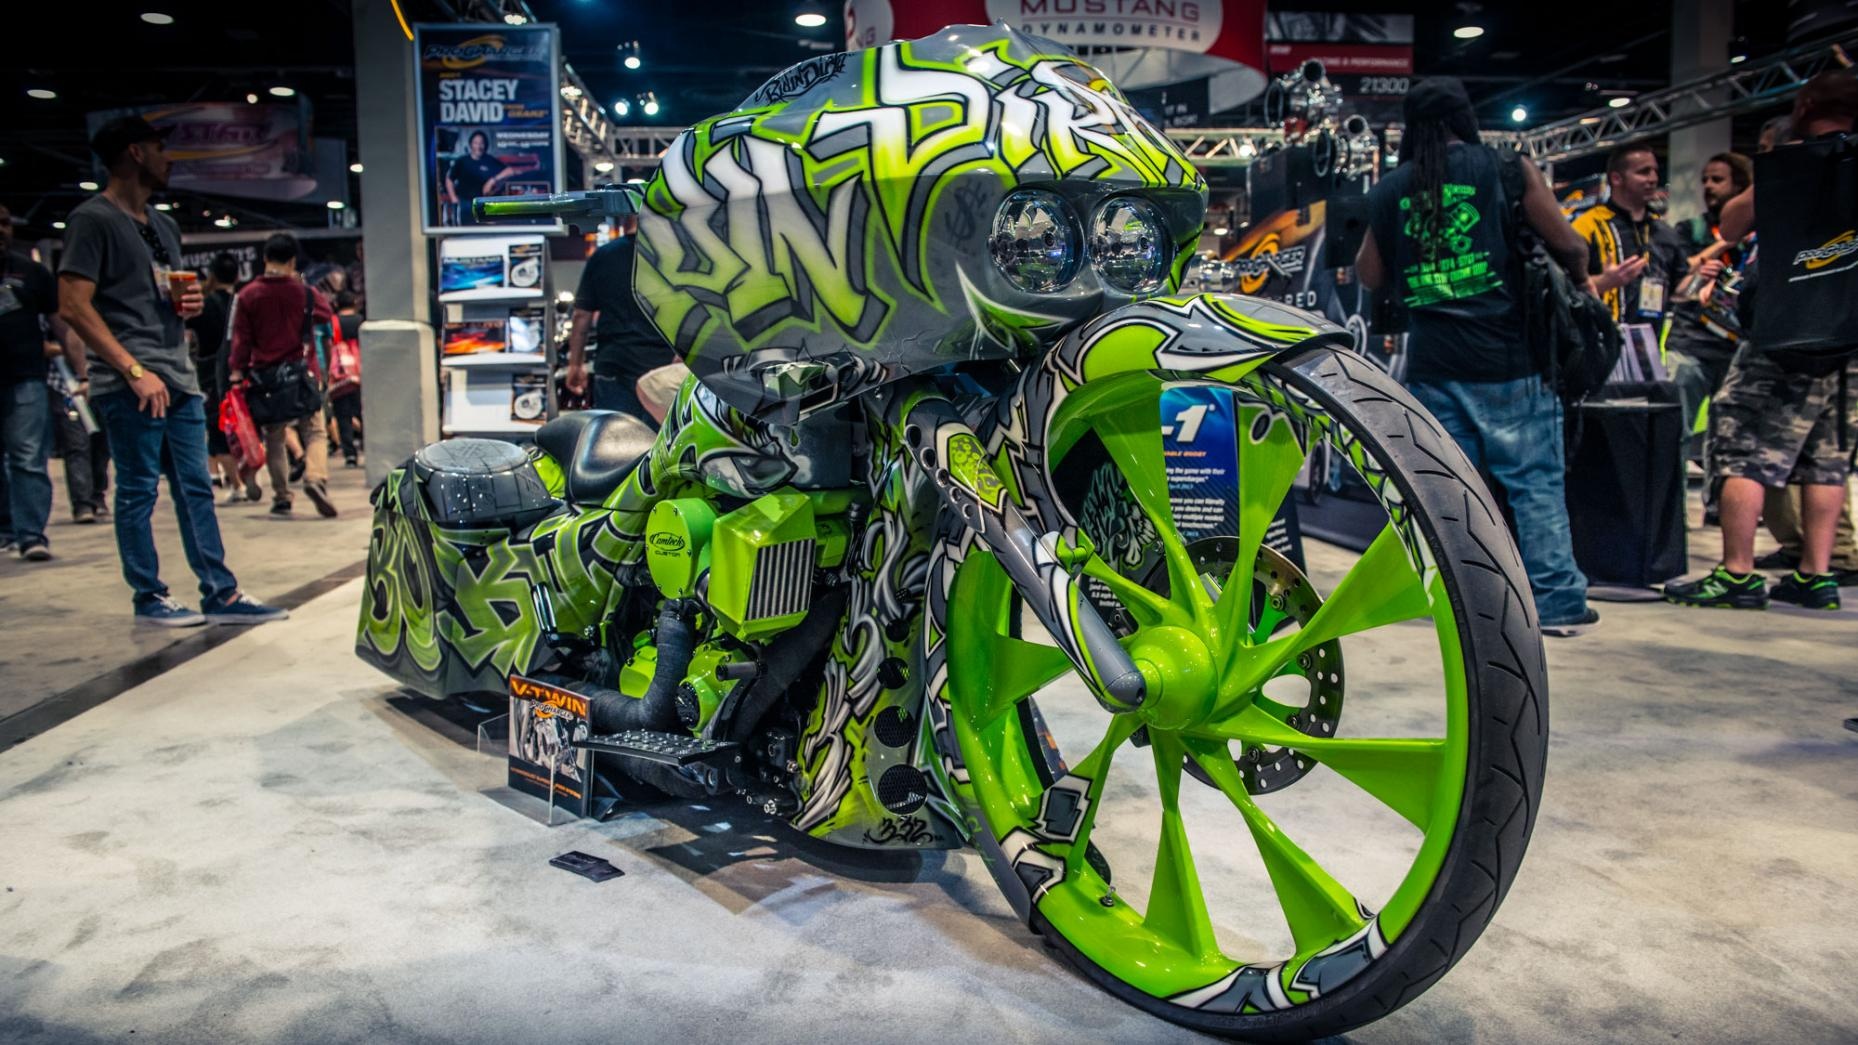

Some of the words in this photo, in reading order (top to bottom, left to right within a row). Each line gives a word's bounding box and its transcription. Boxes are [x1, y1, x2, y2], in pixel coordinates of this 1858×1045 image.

[1020, 0, 1200, 22] MUSTANG
[1022, 23, 1200, 41] DYNAMOMETER
[439, 80, 518, 100] STACEY
[1360, 77, 1409, 94] 21300
[441, 102, 503, 122] DAVID
[511, 680, 586, 717] V-TWIN
